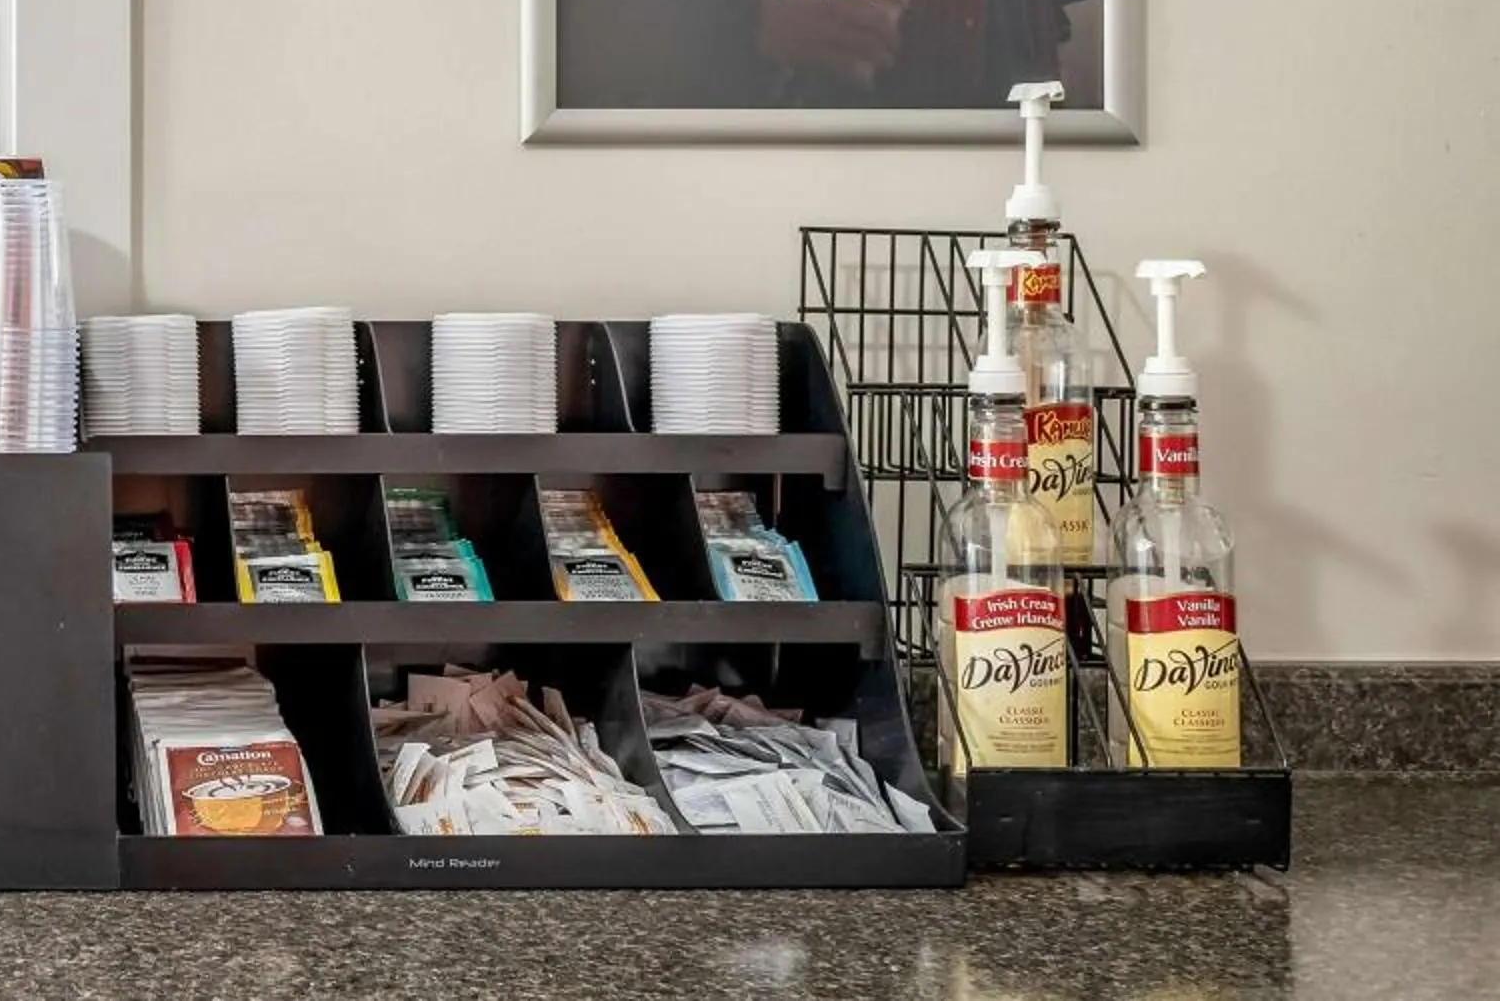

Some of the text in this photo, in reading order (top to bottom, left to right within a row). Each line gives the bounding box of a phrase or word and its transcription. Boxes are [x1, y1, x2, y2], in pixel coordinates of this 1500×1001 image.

[969, 451, 997, 467] rish
[987, 596, 1017, 612] Irish
[1177, 598, 1220, 613] Vanilla
[1177, 613, 1220, 627] Vanille
[962, 639, 1064, 695] DaVinc
[1134, 639, 1238, 696] DaVinc
[408, 858, 501, 868] Mind Reader
